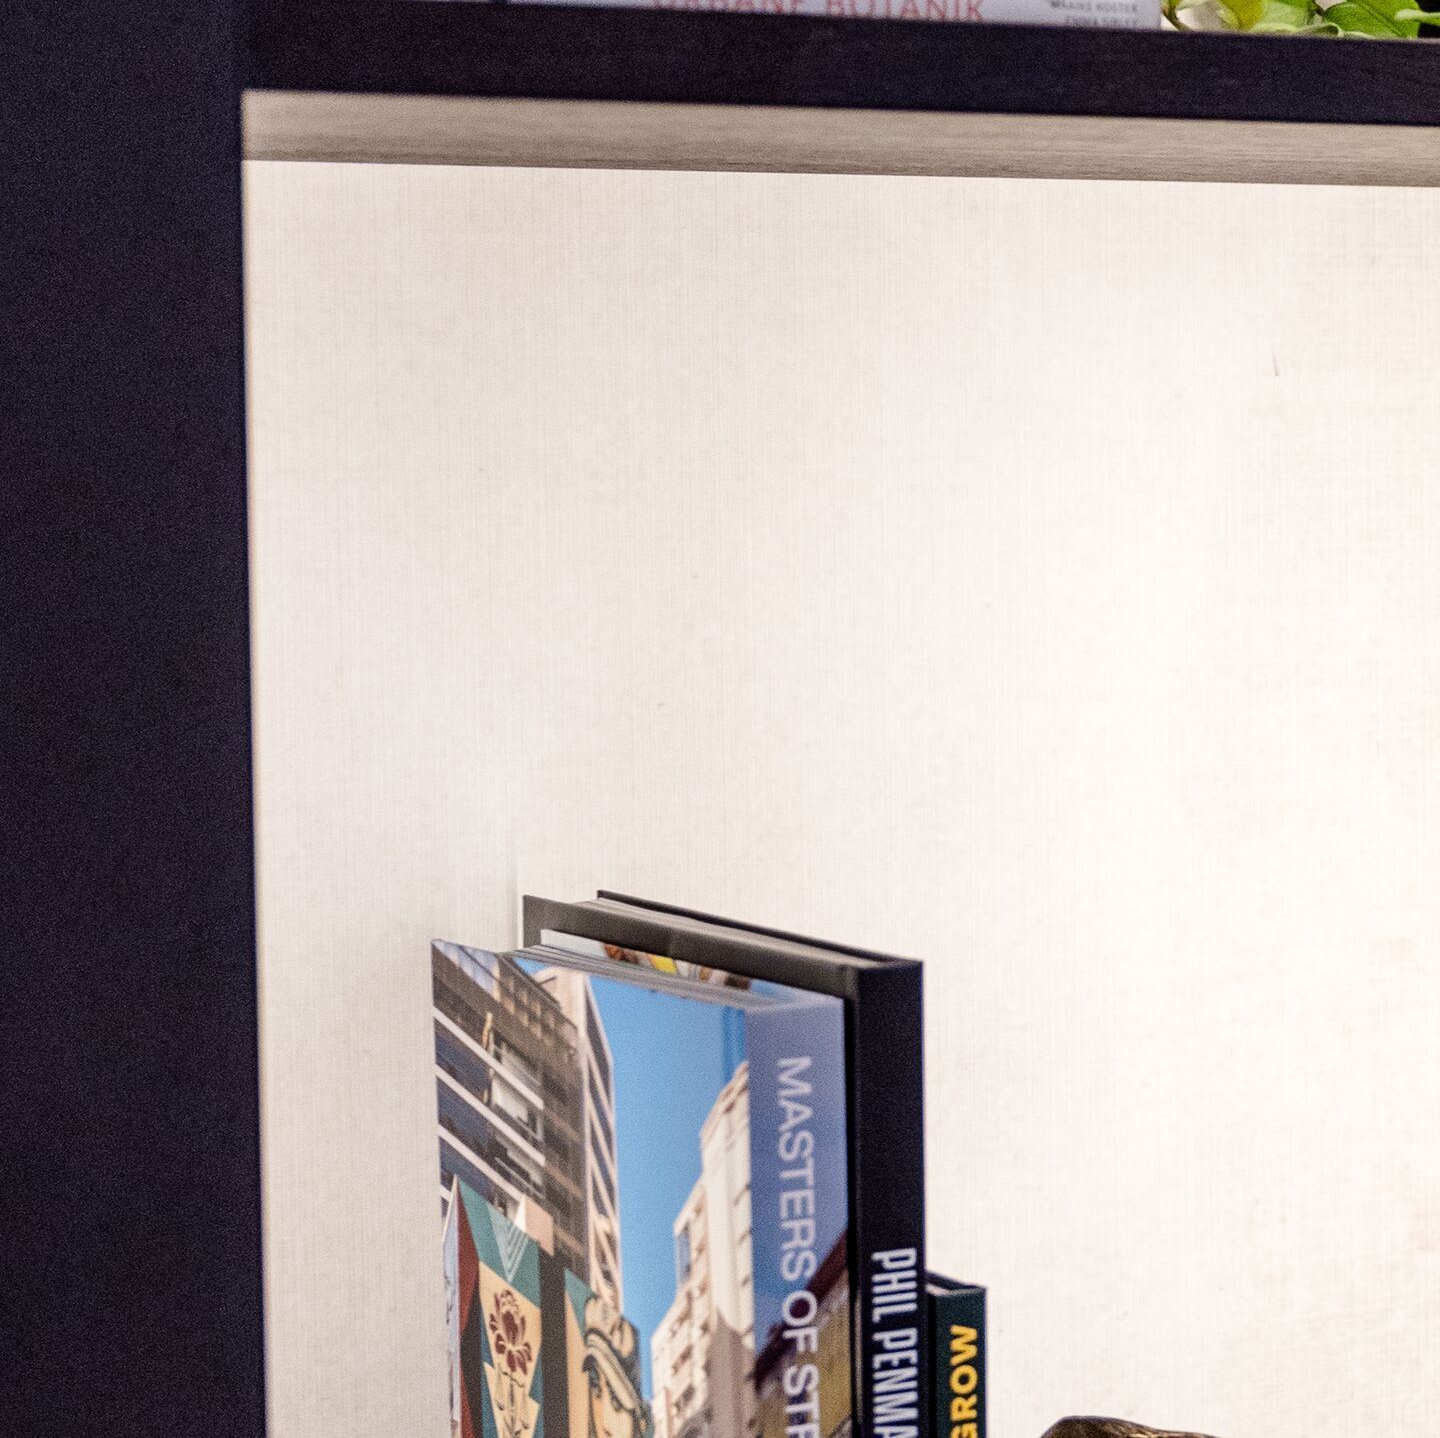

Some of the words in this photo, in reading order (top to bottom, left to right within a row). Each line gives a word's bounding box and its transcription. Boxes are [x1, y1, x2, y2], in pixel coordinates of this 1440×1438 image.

[777, 1055, 817, 1283] MASTERS
[782, 1289, 819, 1354] OF
[871, 1246, 918, 1324] PHIL
